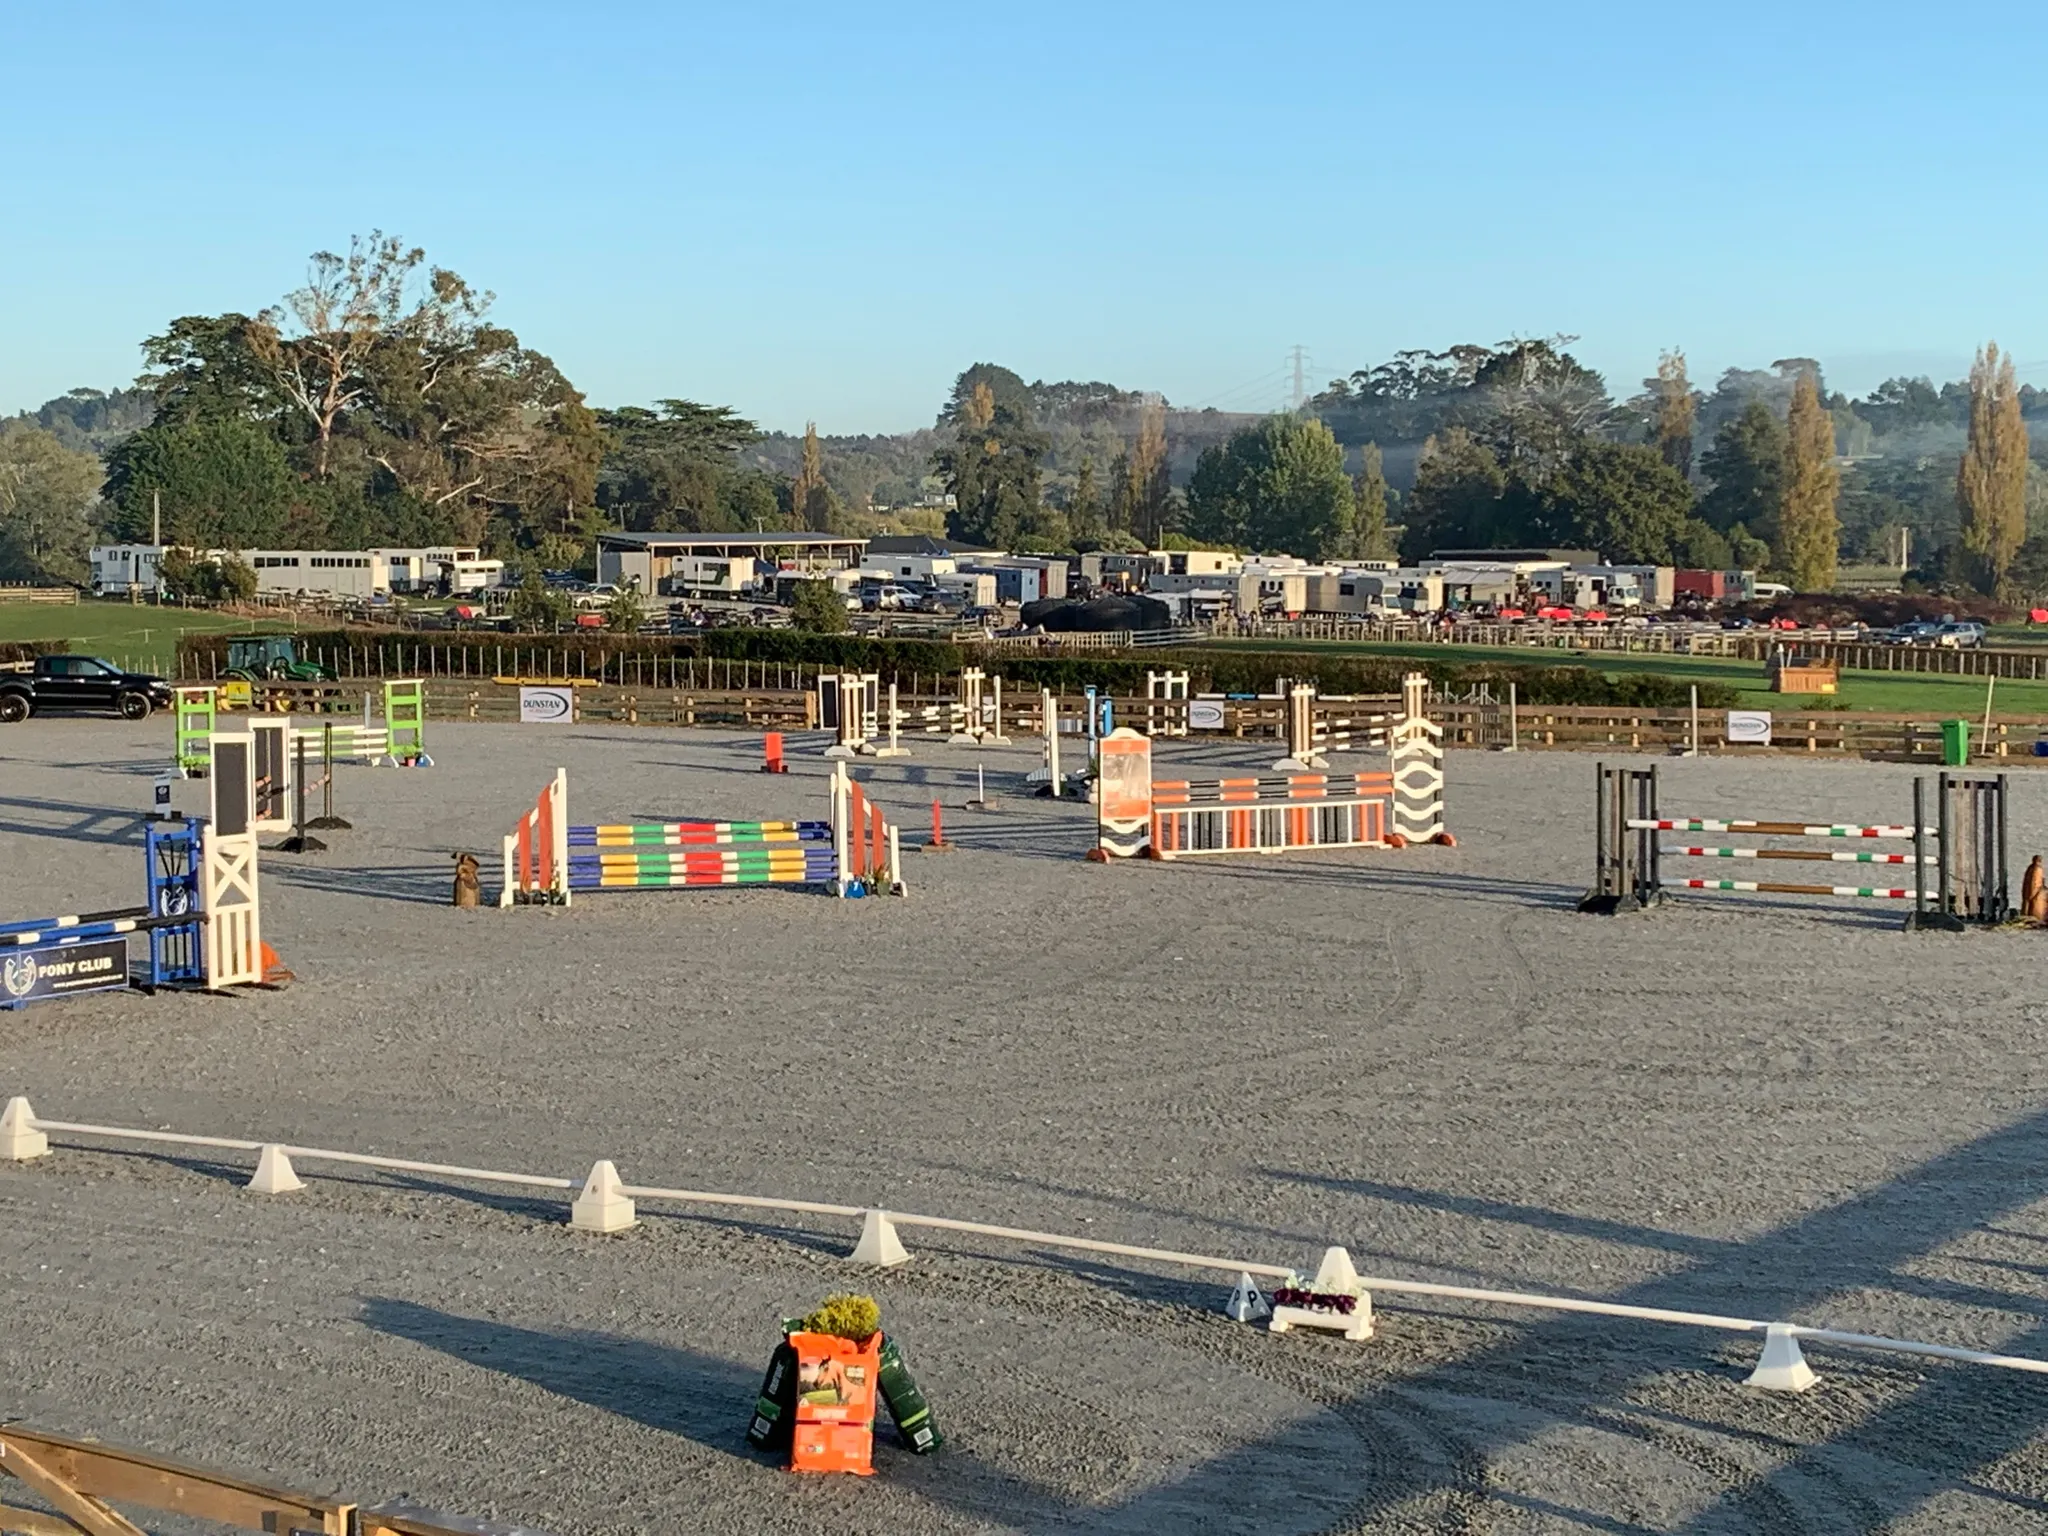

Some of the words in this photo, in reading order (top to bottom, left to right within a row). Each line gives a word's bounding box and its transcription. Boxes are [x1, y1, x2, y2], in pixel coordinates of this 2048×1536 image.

[523, 699, 561, 708] DUNSTAN
[38, 962, 75, 978] PONY
[78, 957, 113, 973] CLUB
[1247, 1290, 1258, 1309] P
